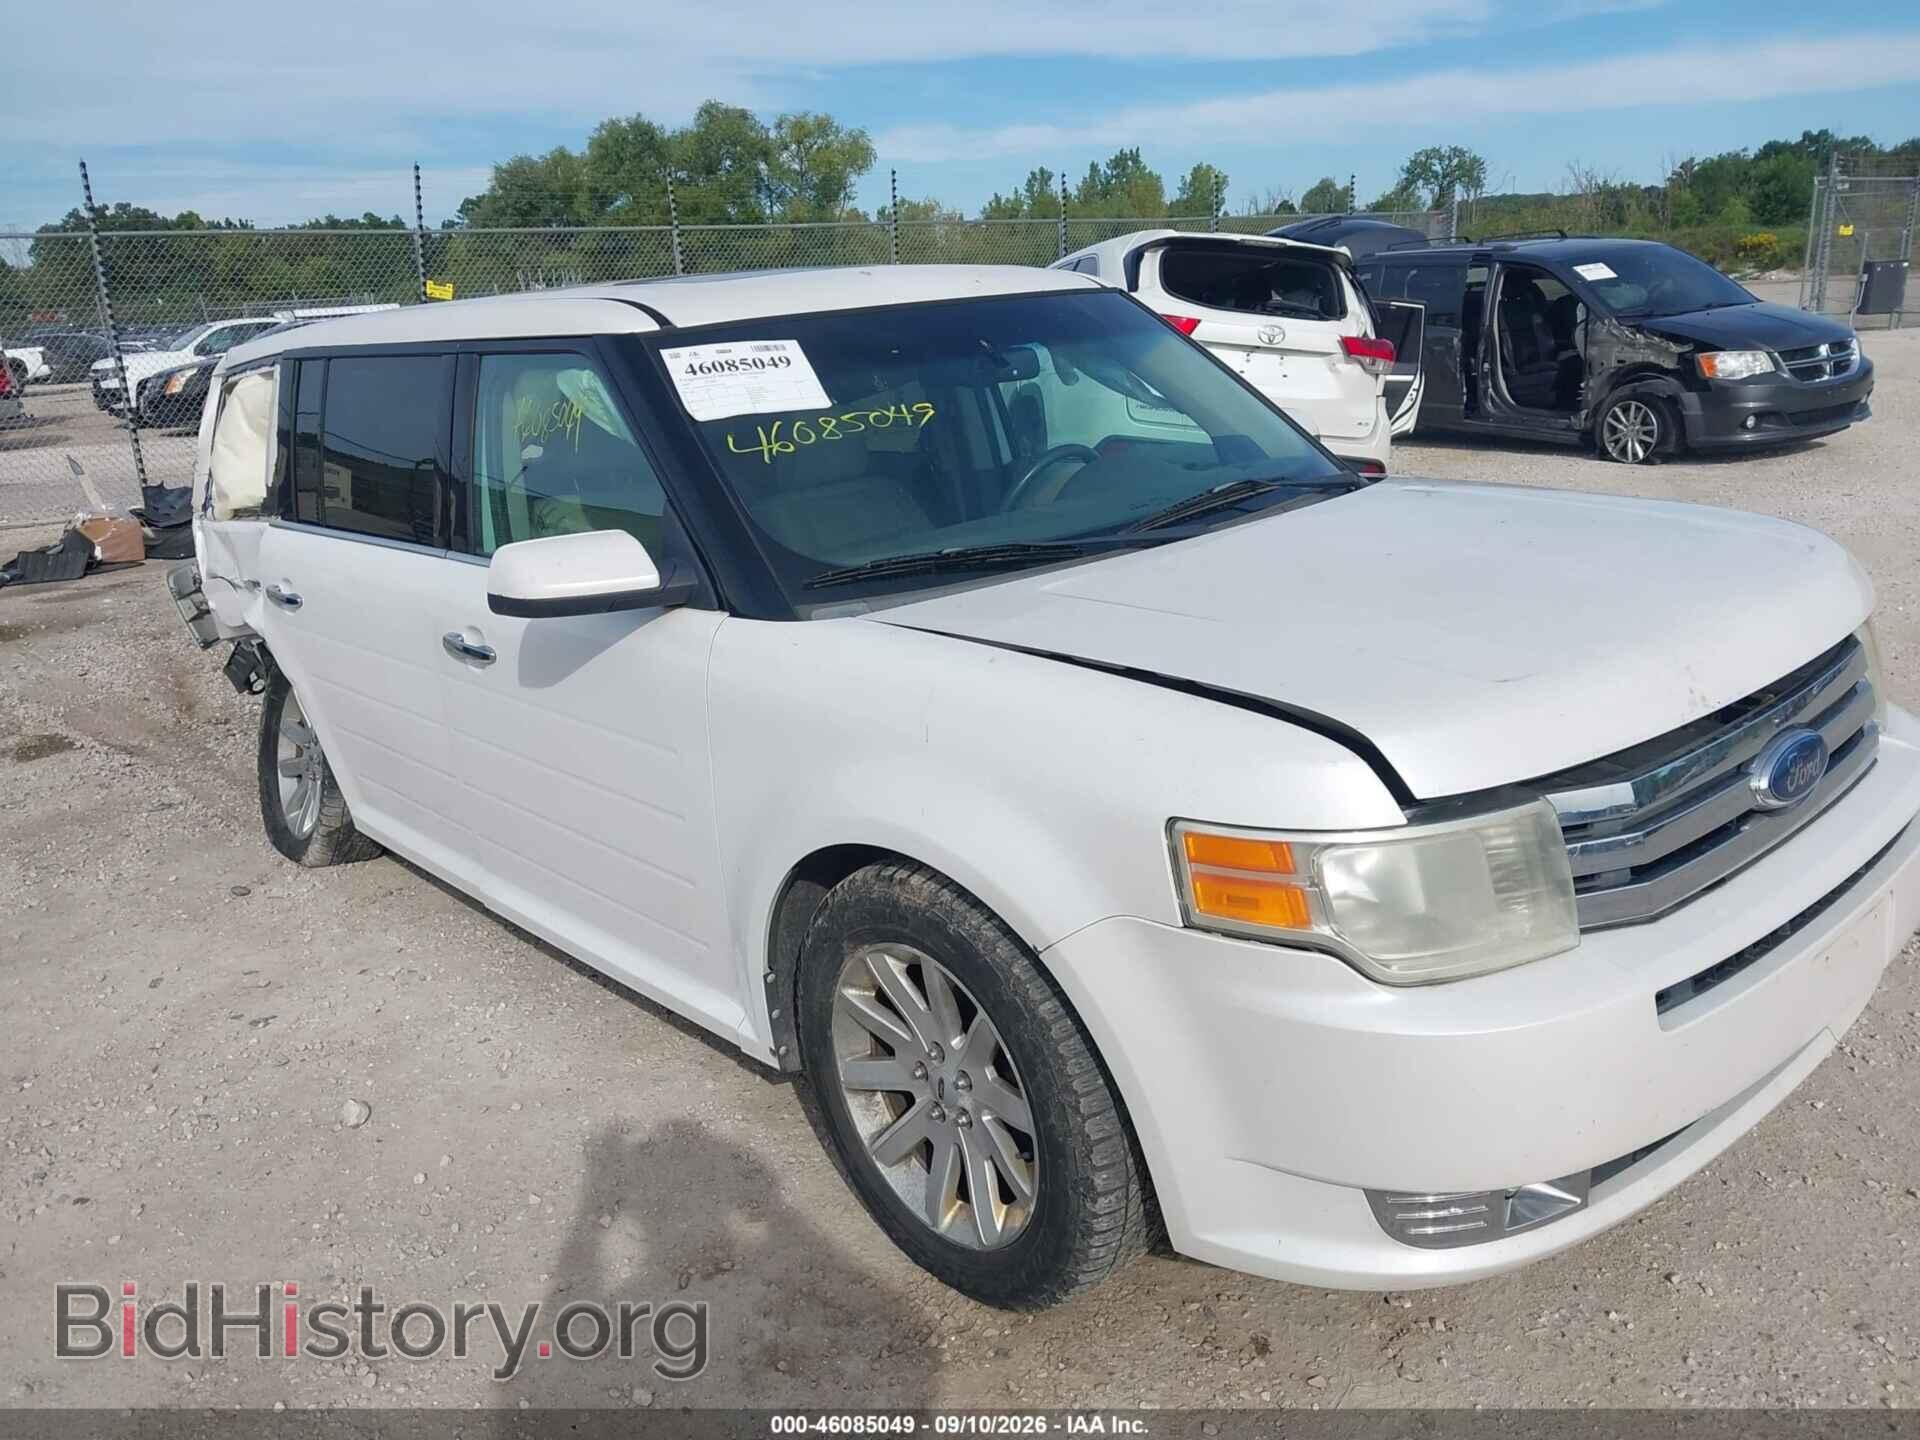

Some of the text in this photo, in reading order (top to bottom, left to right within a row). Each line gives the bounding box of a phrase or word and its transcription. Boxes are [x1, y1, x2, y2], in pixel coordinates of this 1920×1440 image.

[684, 355, 791, 376] 46085049
[727, 402, 936, 464] 46085049
[1786, 750, 1821, 793] Ford
